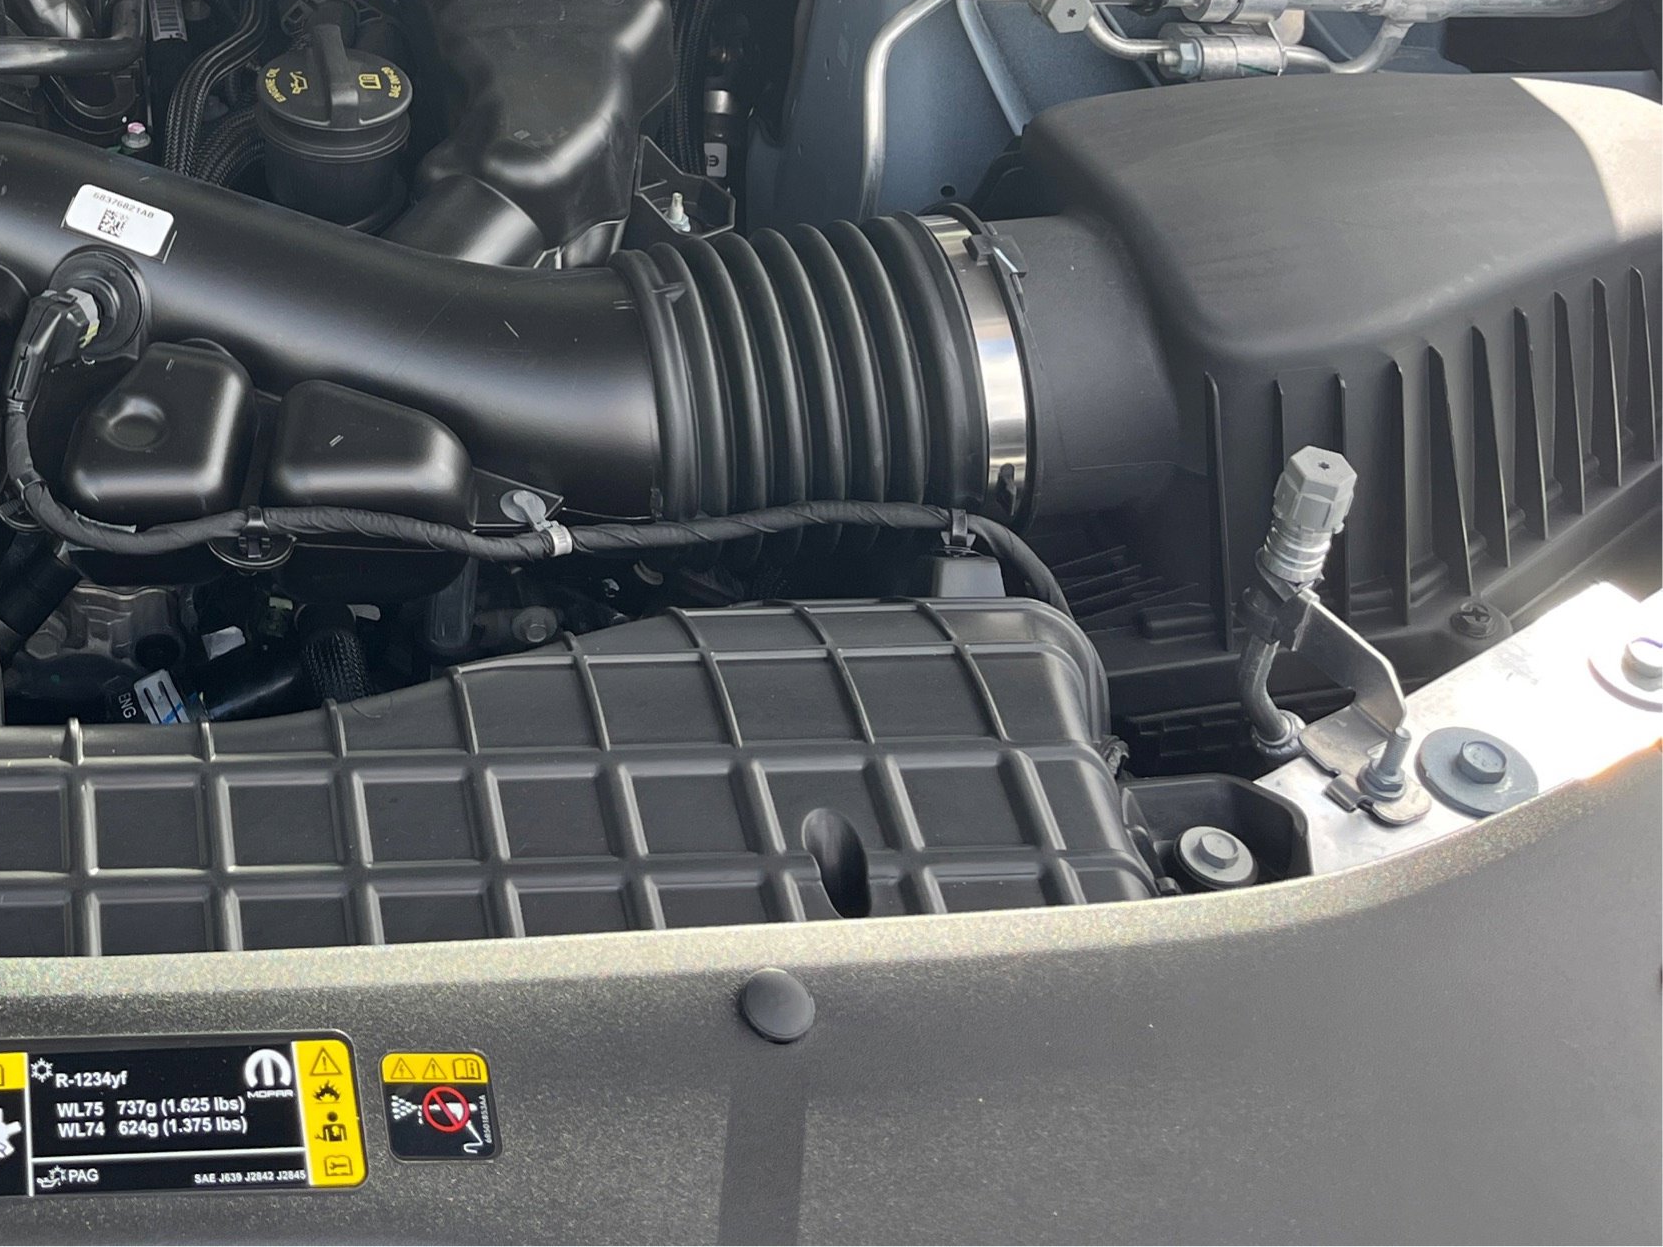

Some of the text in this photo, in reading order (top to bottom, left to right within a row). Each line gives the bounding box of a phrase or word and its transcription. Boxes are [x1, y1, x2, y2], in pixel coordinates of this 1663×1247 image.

[266, 67, 281, 78] OIL
[118, 692, 137, 719] ENG
[55, 1070, 128, 1091] R-1234yf
[246, 1088, 294, 1099] MOPAR
[56, 1095, 246, 1120] WL75 737g (1.625 lbs)
[58, 1115, 248, 1140] WL74 624g (1.375 lbs)
[68, 1168, 99, 1183] PAG
[194, 1172, 217, 1184] SAE
[244, 1170, 274, 1183] J2842
[276, 1169, 306, 1181] J2845
